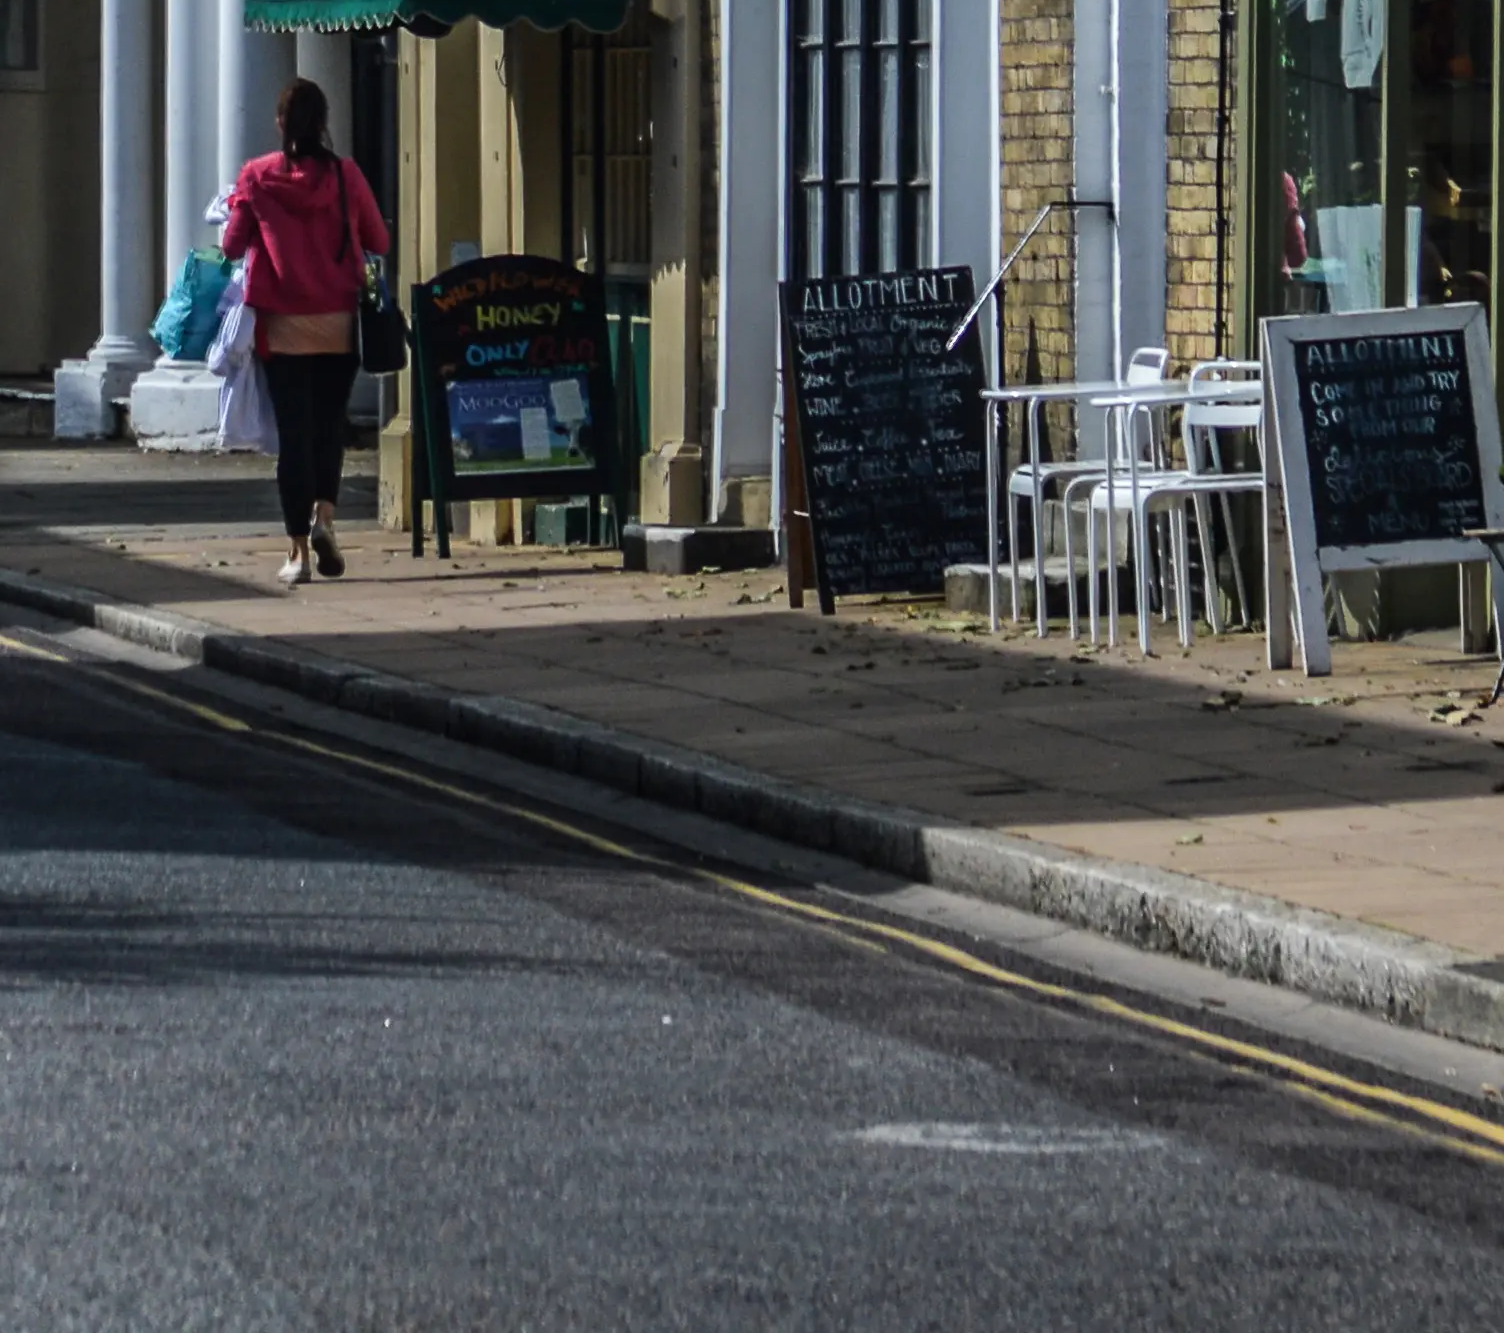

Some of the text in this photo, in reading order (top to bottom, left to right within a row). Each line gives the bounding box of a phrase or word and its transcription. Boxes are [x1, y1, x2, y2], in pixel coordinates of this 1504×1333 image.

[803, 274, 958, 313] ALLOTMENT
[476, 301, 561, 331] HONEY
[465, 337, 530, 367] ONLY
[1306, 336, 1457, 368] ALLOTMENT
[1427, 369, 1461, 391] TRY
